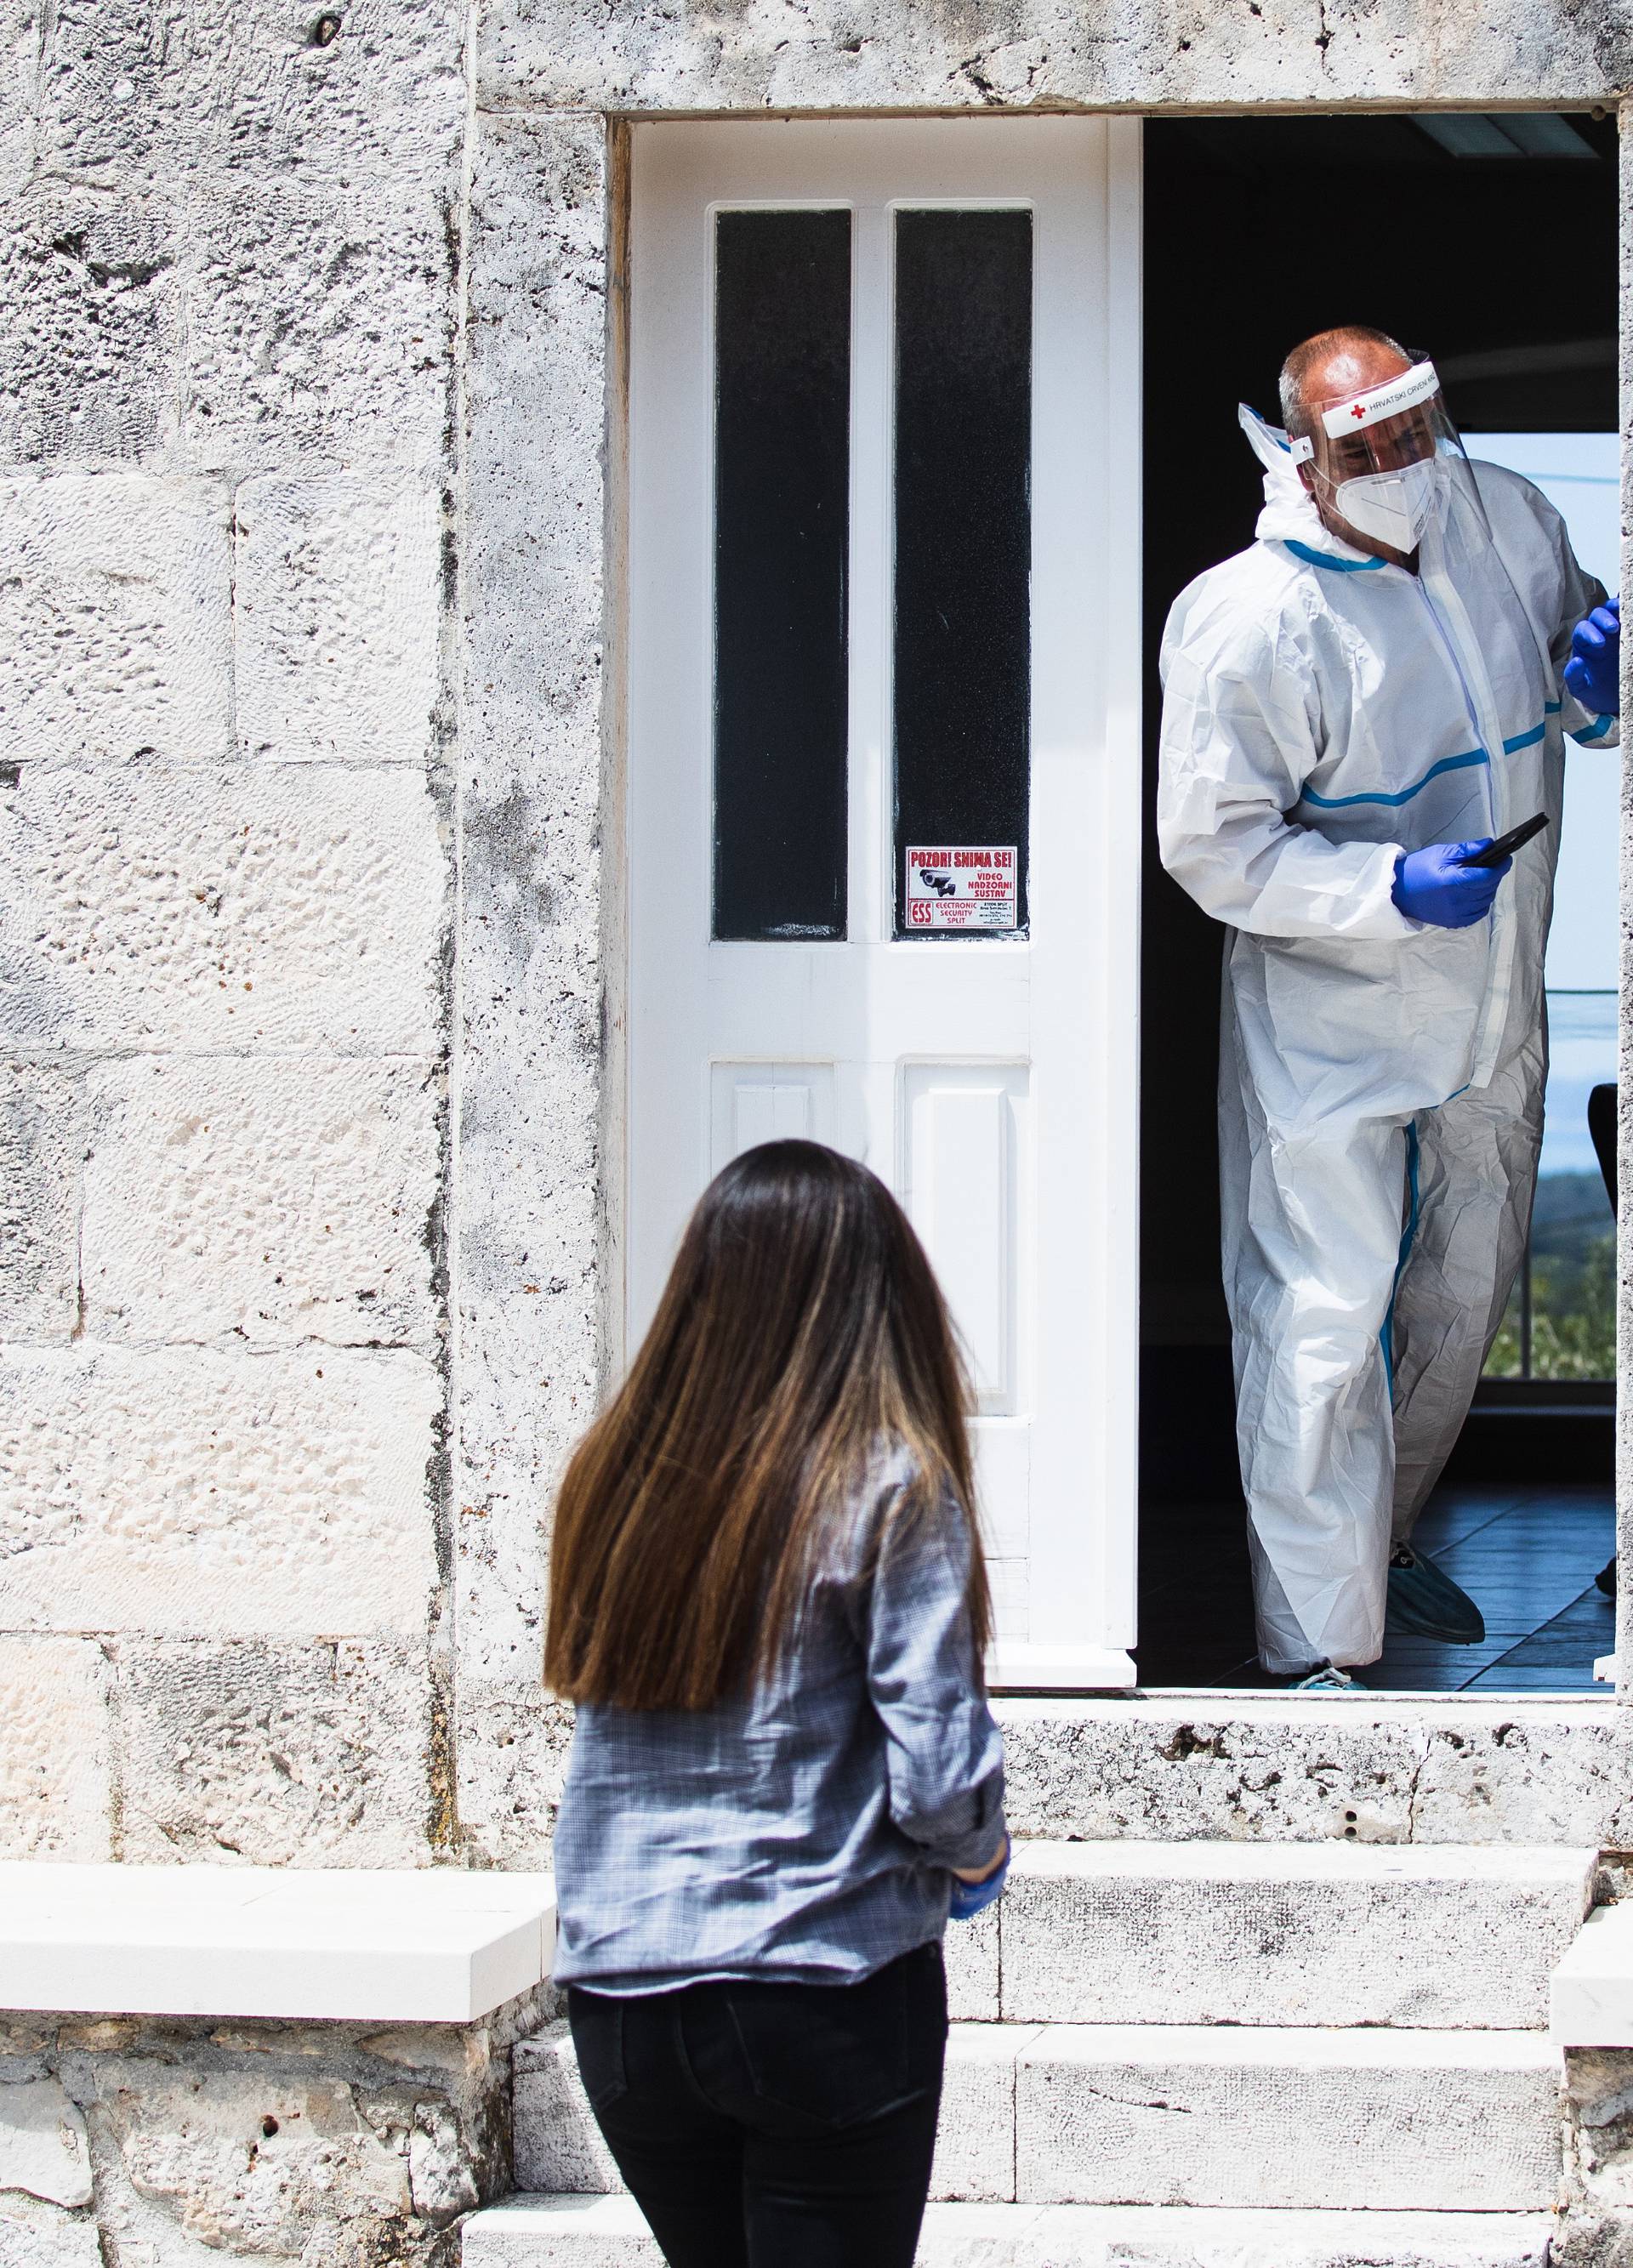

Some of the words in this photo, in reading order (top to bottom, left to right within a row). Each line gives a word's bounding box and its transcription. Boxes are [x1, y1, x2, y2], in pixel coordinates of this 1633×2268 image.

[1369, 391, 1406, 411] HRVATSKI
[1408, 379, 1427, 395] CRVENI
[911, 851, 952, 867] POZOR!
[954, 851, 992, 867] SNIMA
[994, 851, 1012, 867] SE!
[977, 873, 1003, 881] VIDEO
[968, 881, 1012, 890] NADZORNI
[974, 890, 1006, 898] SUSTAV
[912, 903, 931, 923] ESS
